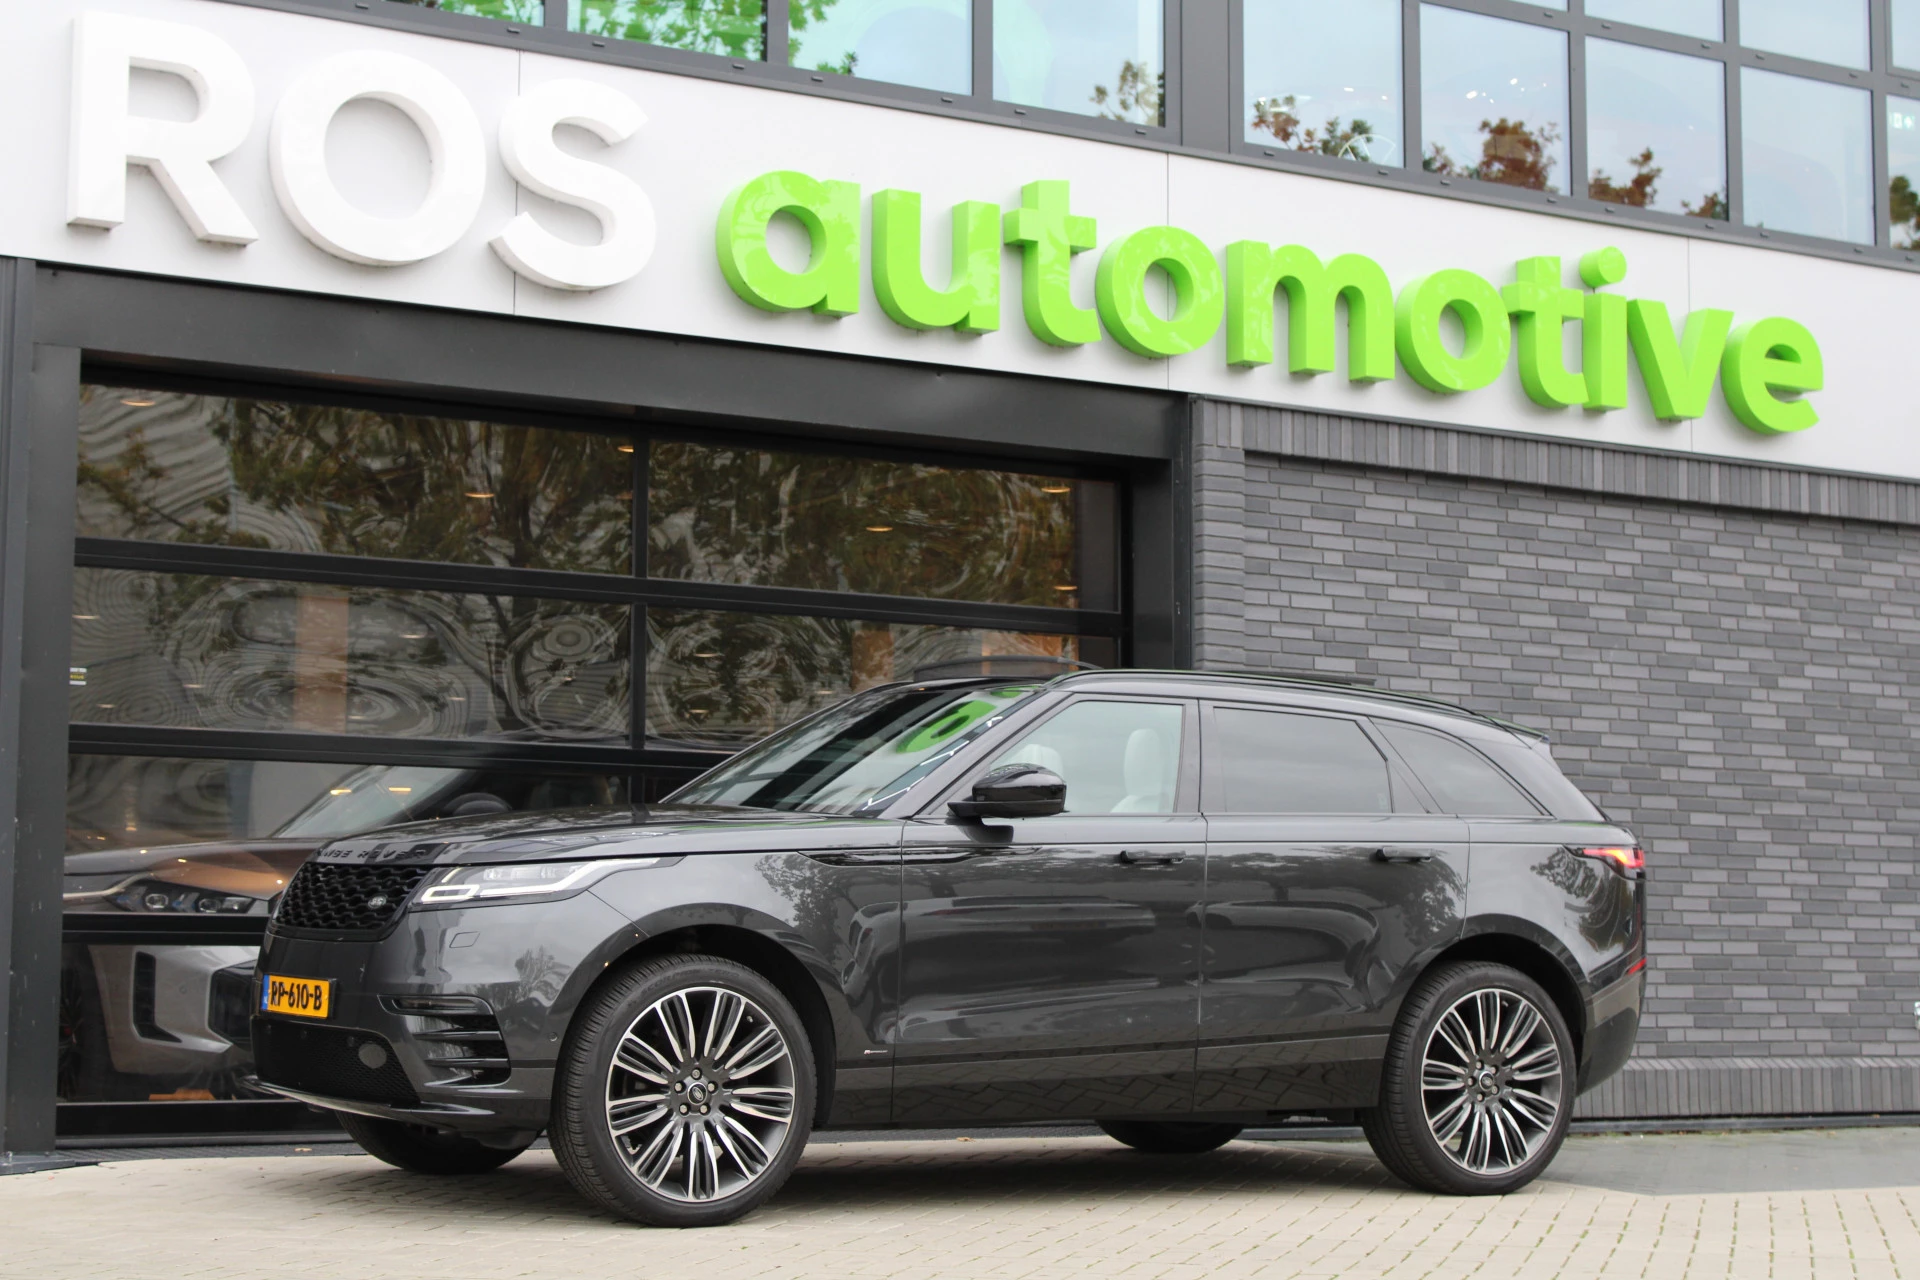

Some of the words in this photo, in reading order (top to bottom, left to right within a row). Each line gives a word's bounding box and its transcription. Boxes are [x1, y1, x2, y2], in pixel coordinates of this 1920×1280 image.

[67, 11, 656, 291] ROS
[715, 170, 1824, 437] automotive
[270, 980, 322, 1011] RP-610-B
